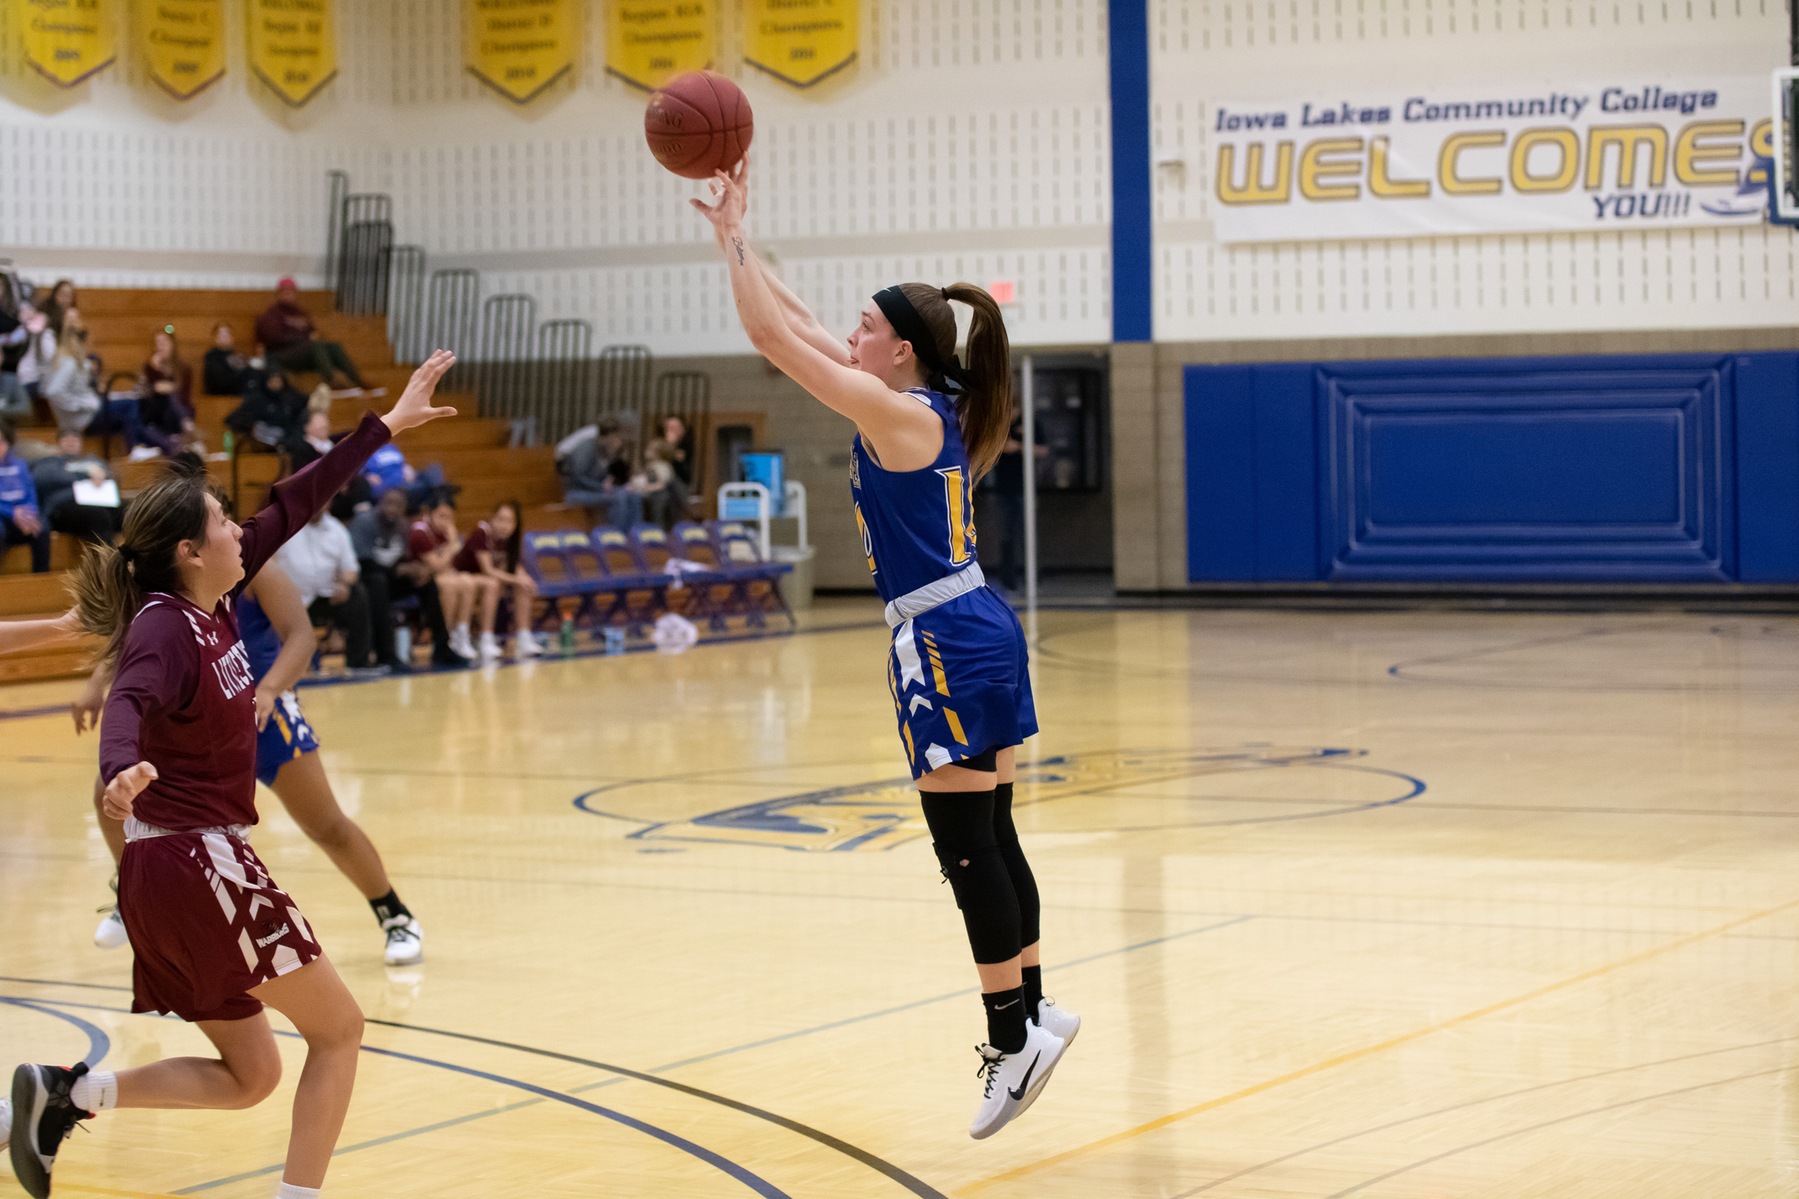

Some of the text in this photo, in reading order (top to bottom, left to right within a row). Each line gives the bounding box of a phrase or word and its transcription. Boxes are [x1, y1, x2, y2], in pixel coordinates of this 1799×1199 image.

[1215, 86, 1719, 132] Iowa Lakes Community College
[1591, 192, 1691, 220] YOU!!!
